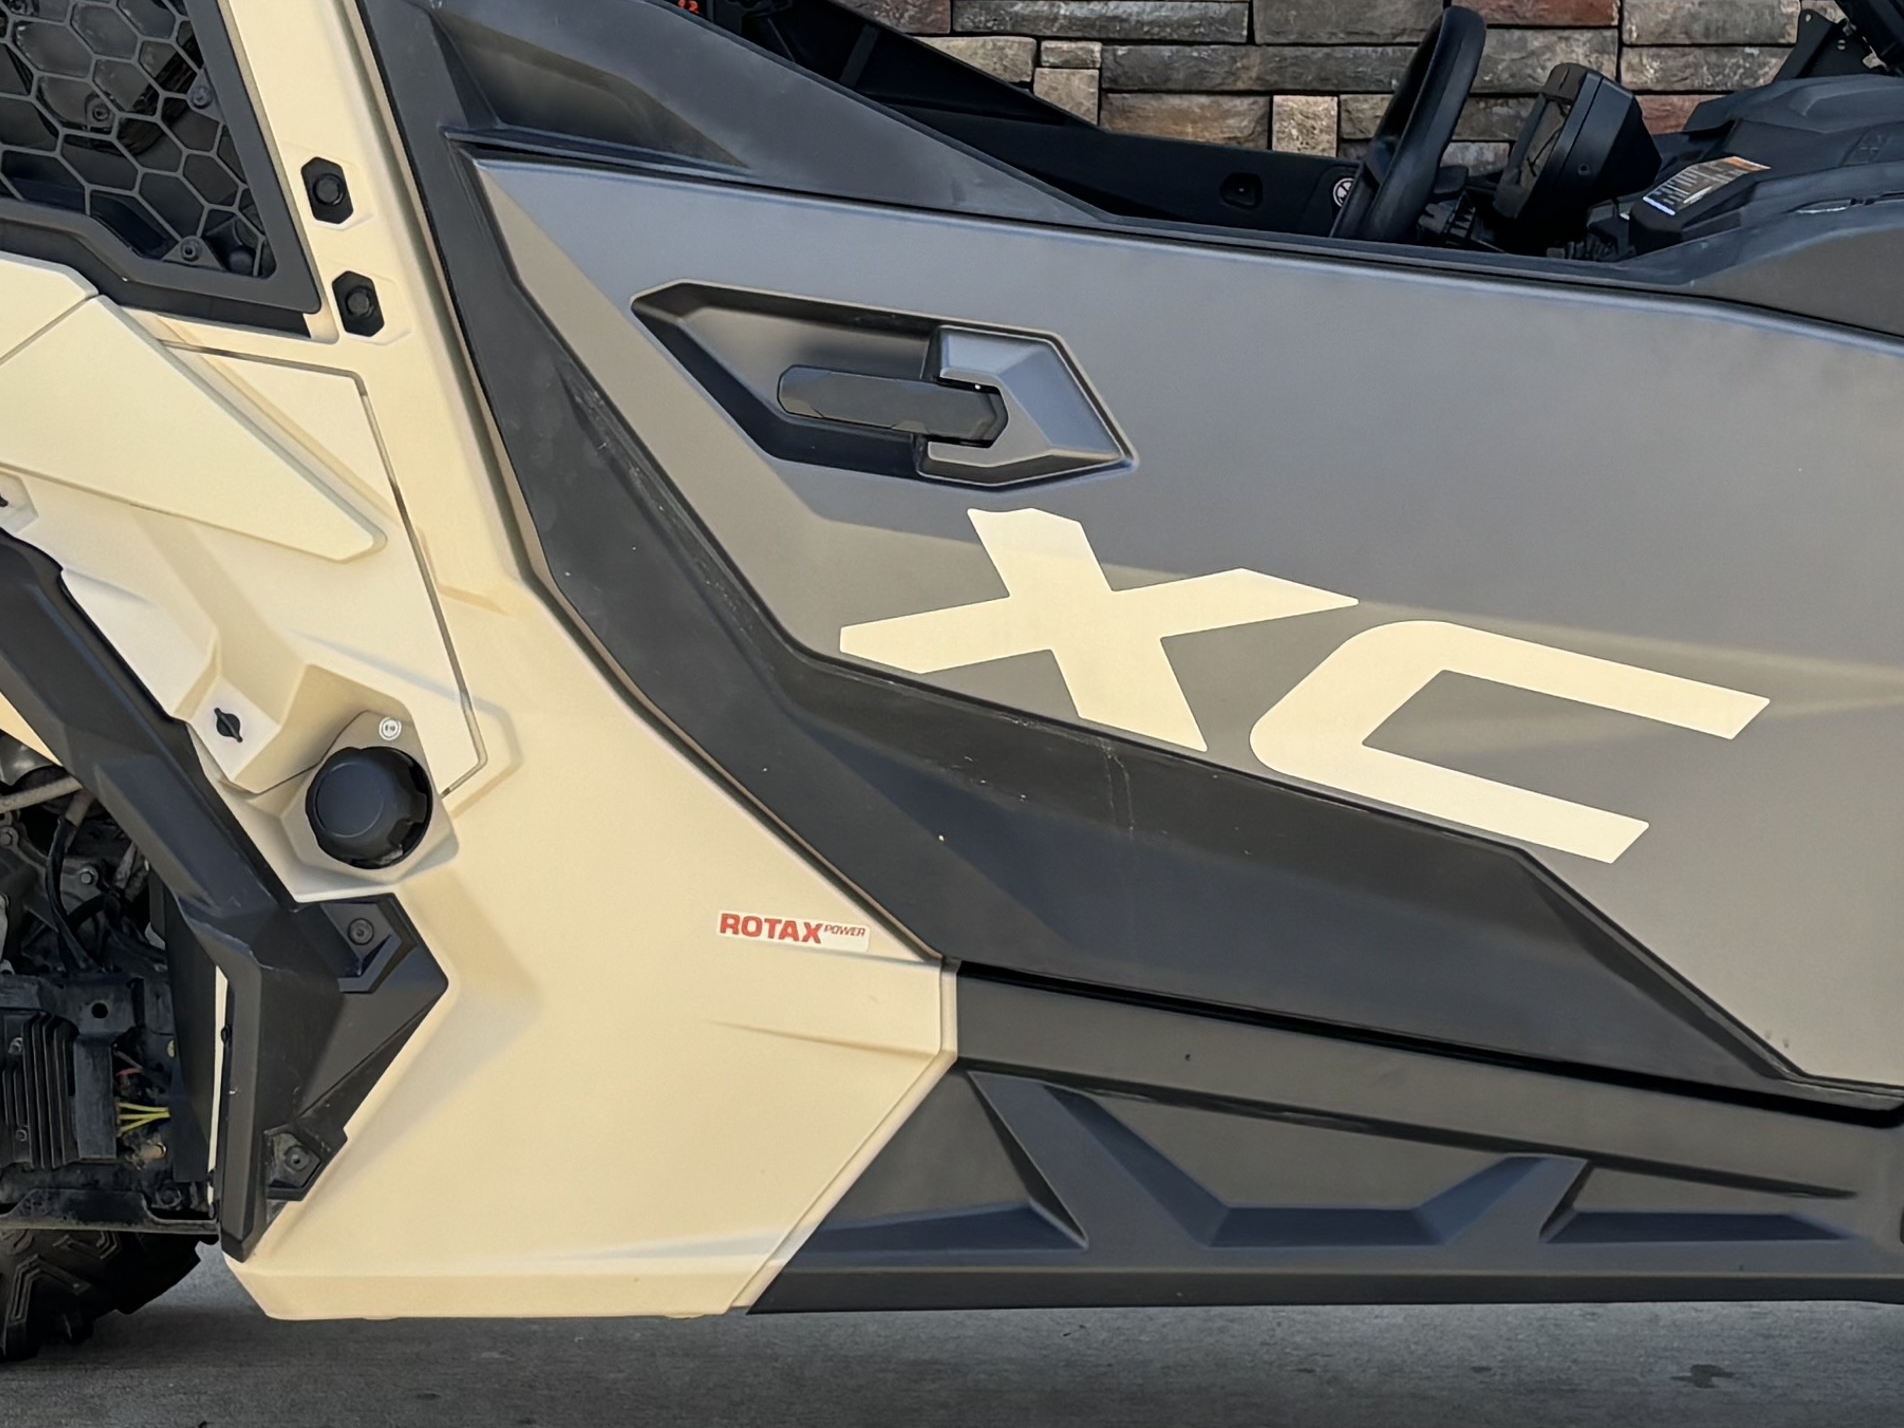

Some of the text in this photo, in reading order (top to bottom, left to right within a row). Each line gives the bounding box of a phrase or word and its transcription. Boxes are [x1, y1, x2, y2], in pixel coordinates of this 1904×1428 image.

[839, 507, 1771, 864] XC
[719, 912, 866, 944] ROTAX POWER
